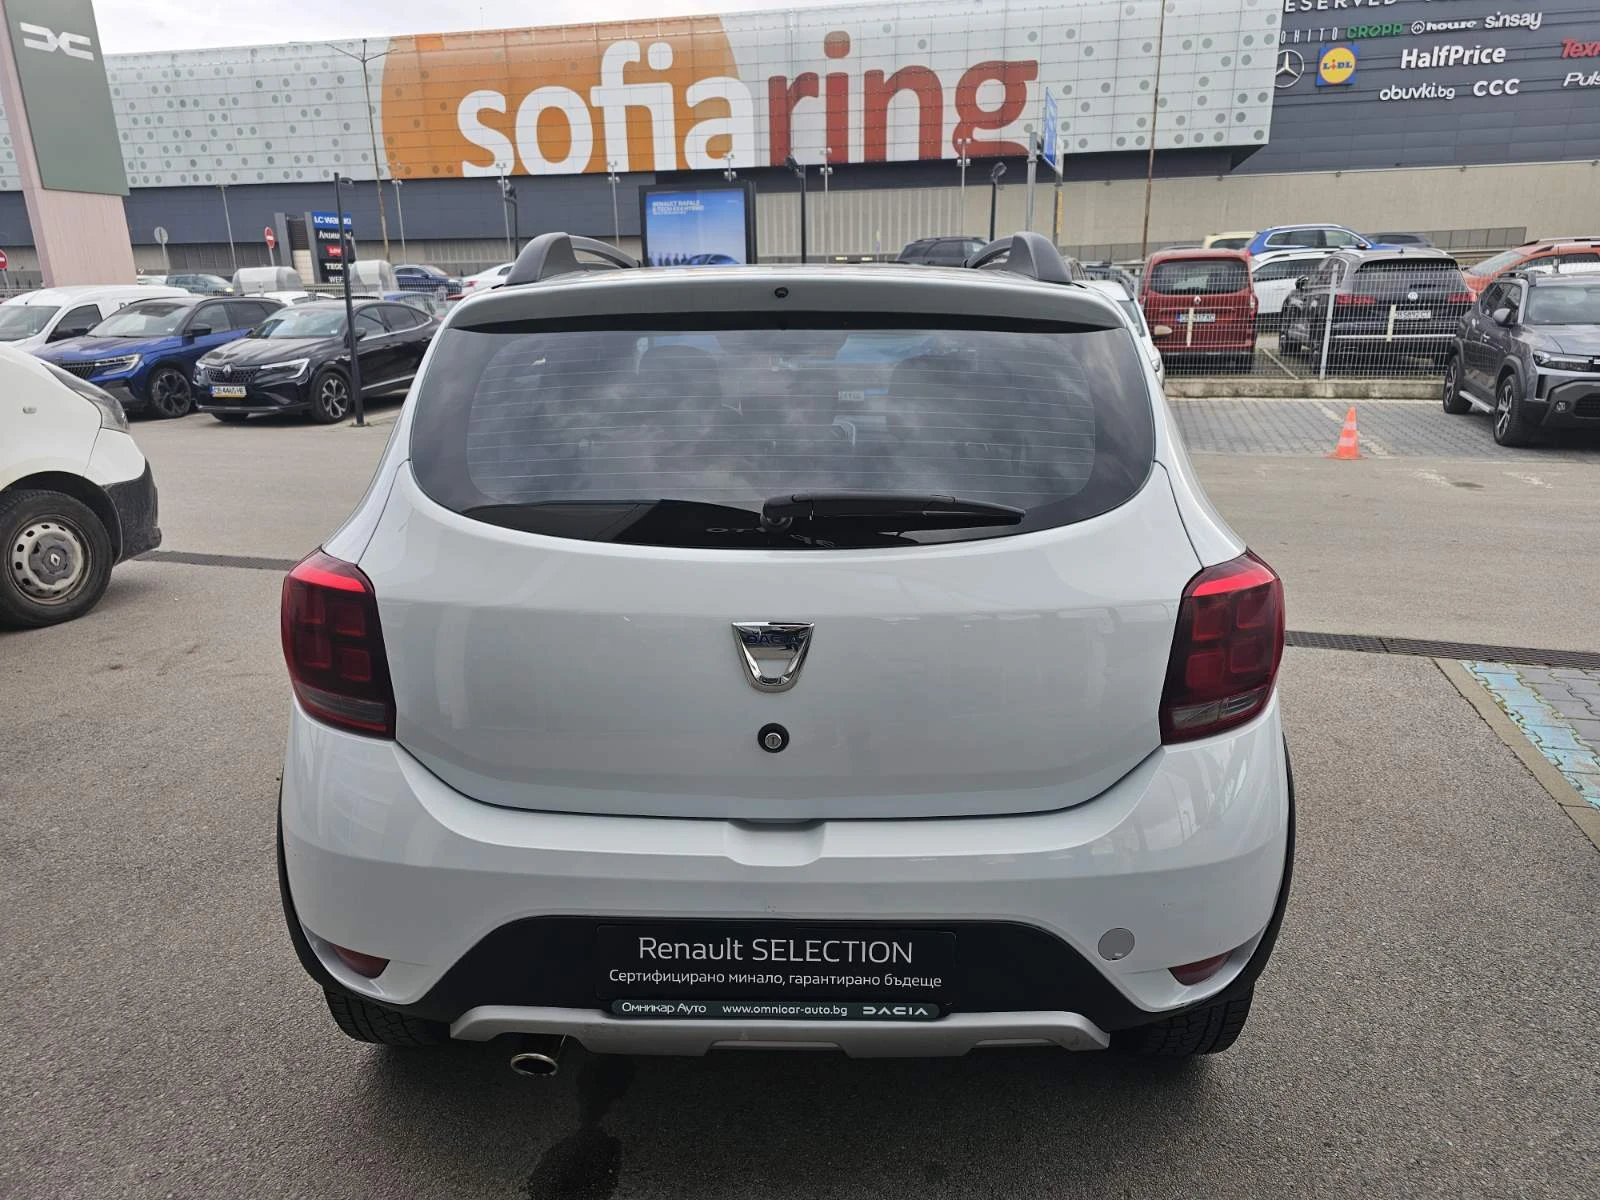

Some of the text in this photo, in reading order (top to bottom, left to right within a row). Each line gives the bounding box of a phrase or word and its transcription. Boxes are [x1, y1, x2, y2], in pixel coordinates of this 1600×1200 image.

[1485, 12, 1542, 30] sinsay
[1346, 23, 1403, 39] CROPP
[1401, 45, 1507, 69] HalfPrice
[1379, 83, 1456, 100] obuvki.bg
[1473, 78, 1520, 97] CCC
[638, 937, 914, 964] Renault SELECTION
[609, 969, 943, 988] Сертифицирано минало, гарантирано бъдеще
[621, 1002, 707, 1014] Омникар Ауто
[722, 1005, 848, 1017] www.omnicar-auto.bg
[862, 1006, 929, 1016] DACIA
